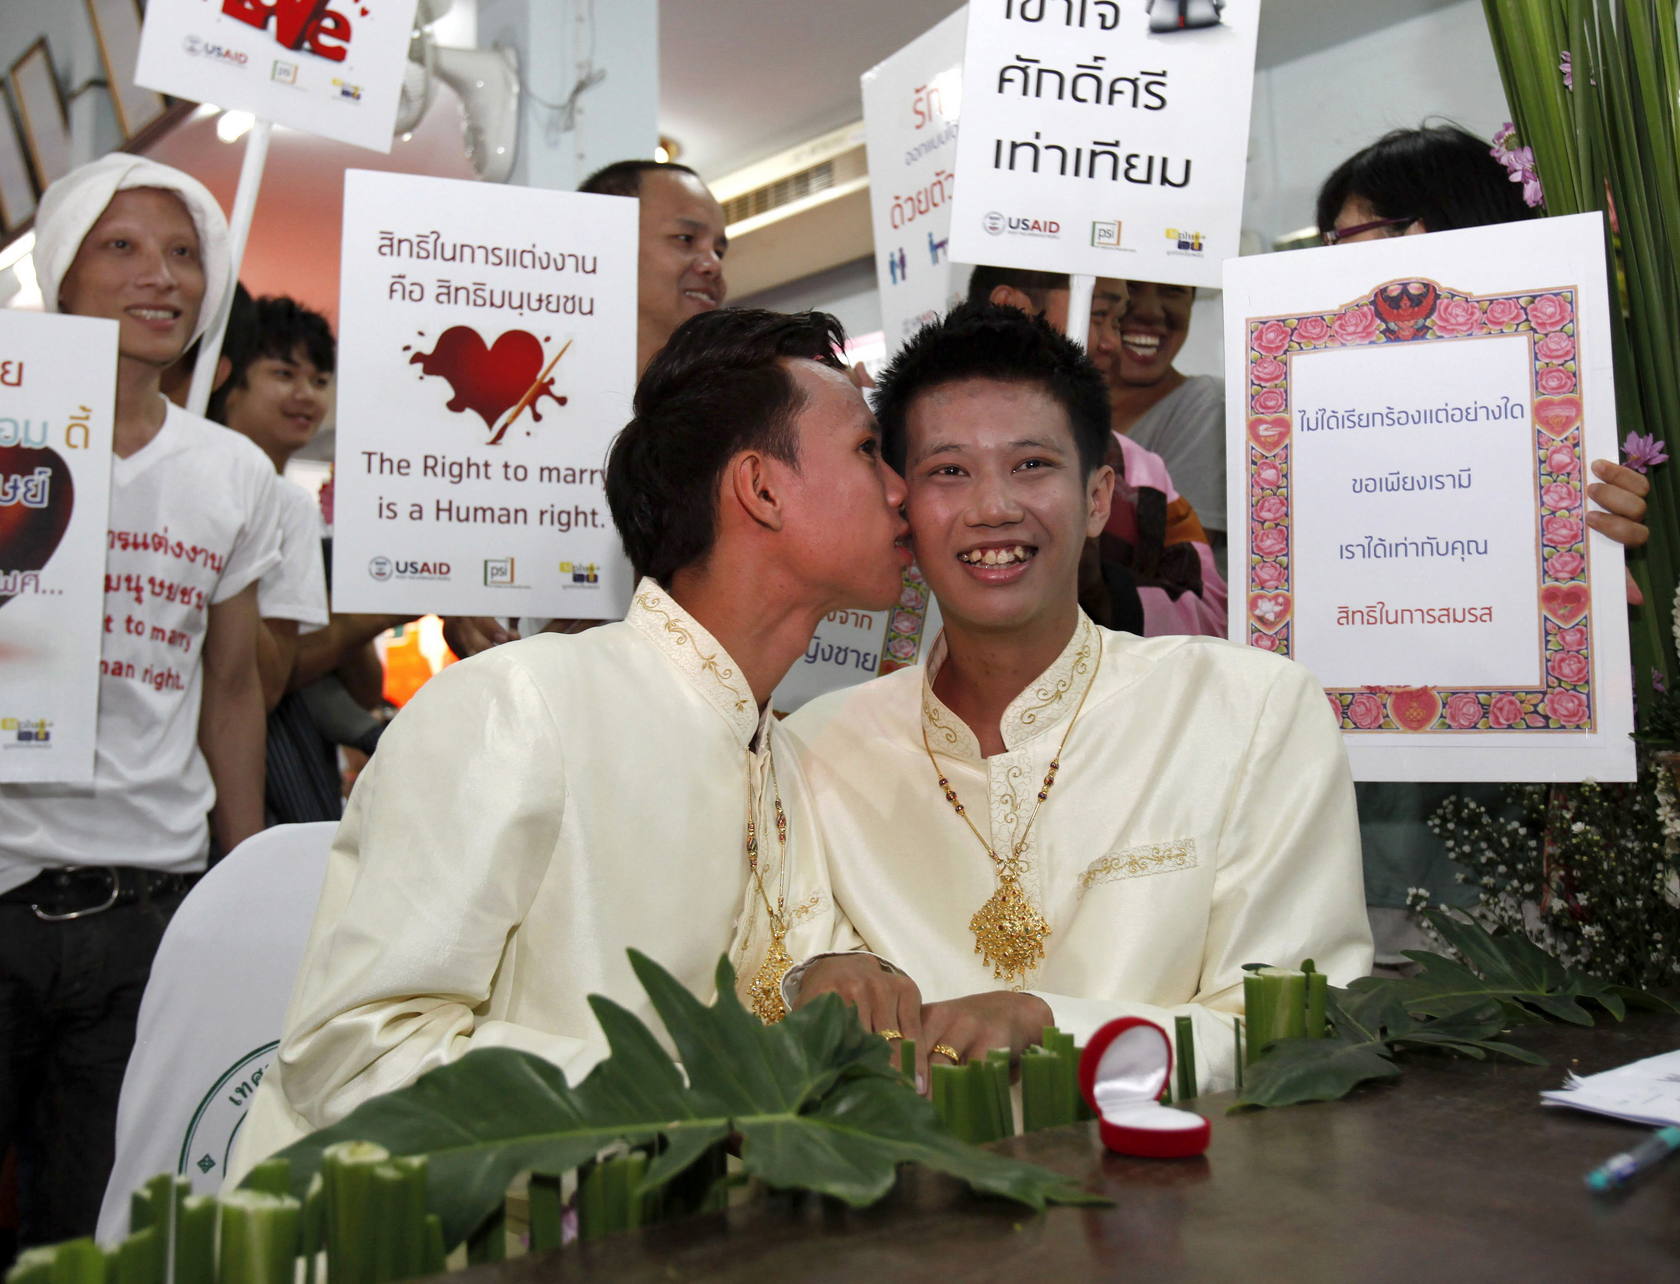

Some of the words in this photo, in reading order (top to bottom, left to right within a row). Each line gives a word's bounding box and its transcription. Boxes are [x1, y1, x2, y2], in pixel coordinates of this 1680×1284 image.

[203, 41, 248, 65] USAID
[997, 54, 1168, 111] ศักดิ์ศรี
[994, 131, 1192, 189] เท่าเทียม
[1007, 216, 1061, 235] USAID
[377, 230, 598, 275] สิทธิในการแต่งงาน
[389, 273, 424, 303] คือ
[435, 278, 595, 317] สิทธิมนุษยชน
[1298, 396, 1525, 432] ไม่ได้เรียกร้องแต่อย่างใด
[361, 451, 411, 476] The
[423, 454, 492, 485] Right
[502, 460, 528, 482] to
[1351, 468, 1472, 494] ขอเพียงเรามี
[377, 495, 398, 520] is
[408, 502, 424, 521] a
[435, 499, 528, 525] Human
[538, 504, 606, 533] right.
[1339, 535, 1489, 563] เราได้เท่ากับคุณ
[395, 561, 451, 576] USAID
[125, 614, 145, 636] to
[1336, 601, 1494, 627] สิทธิในการสมรส
